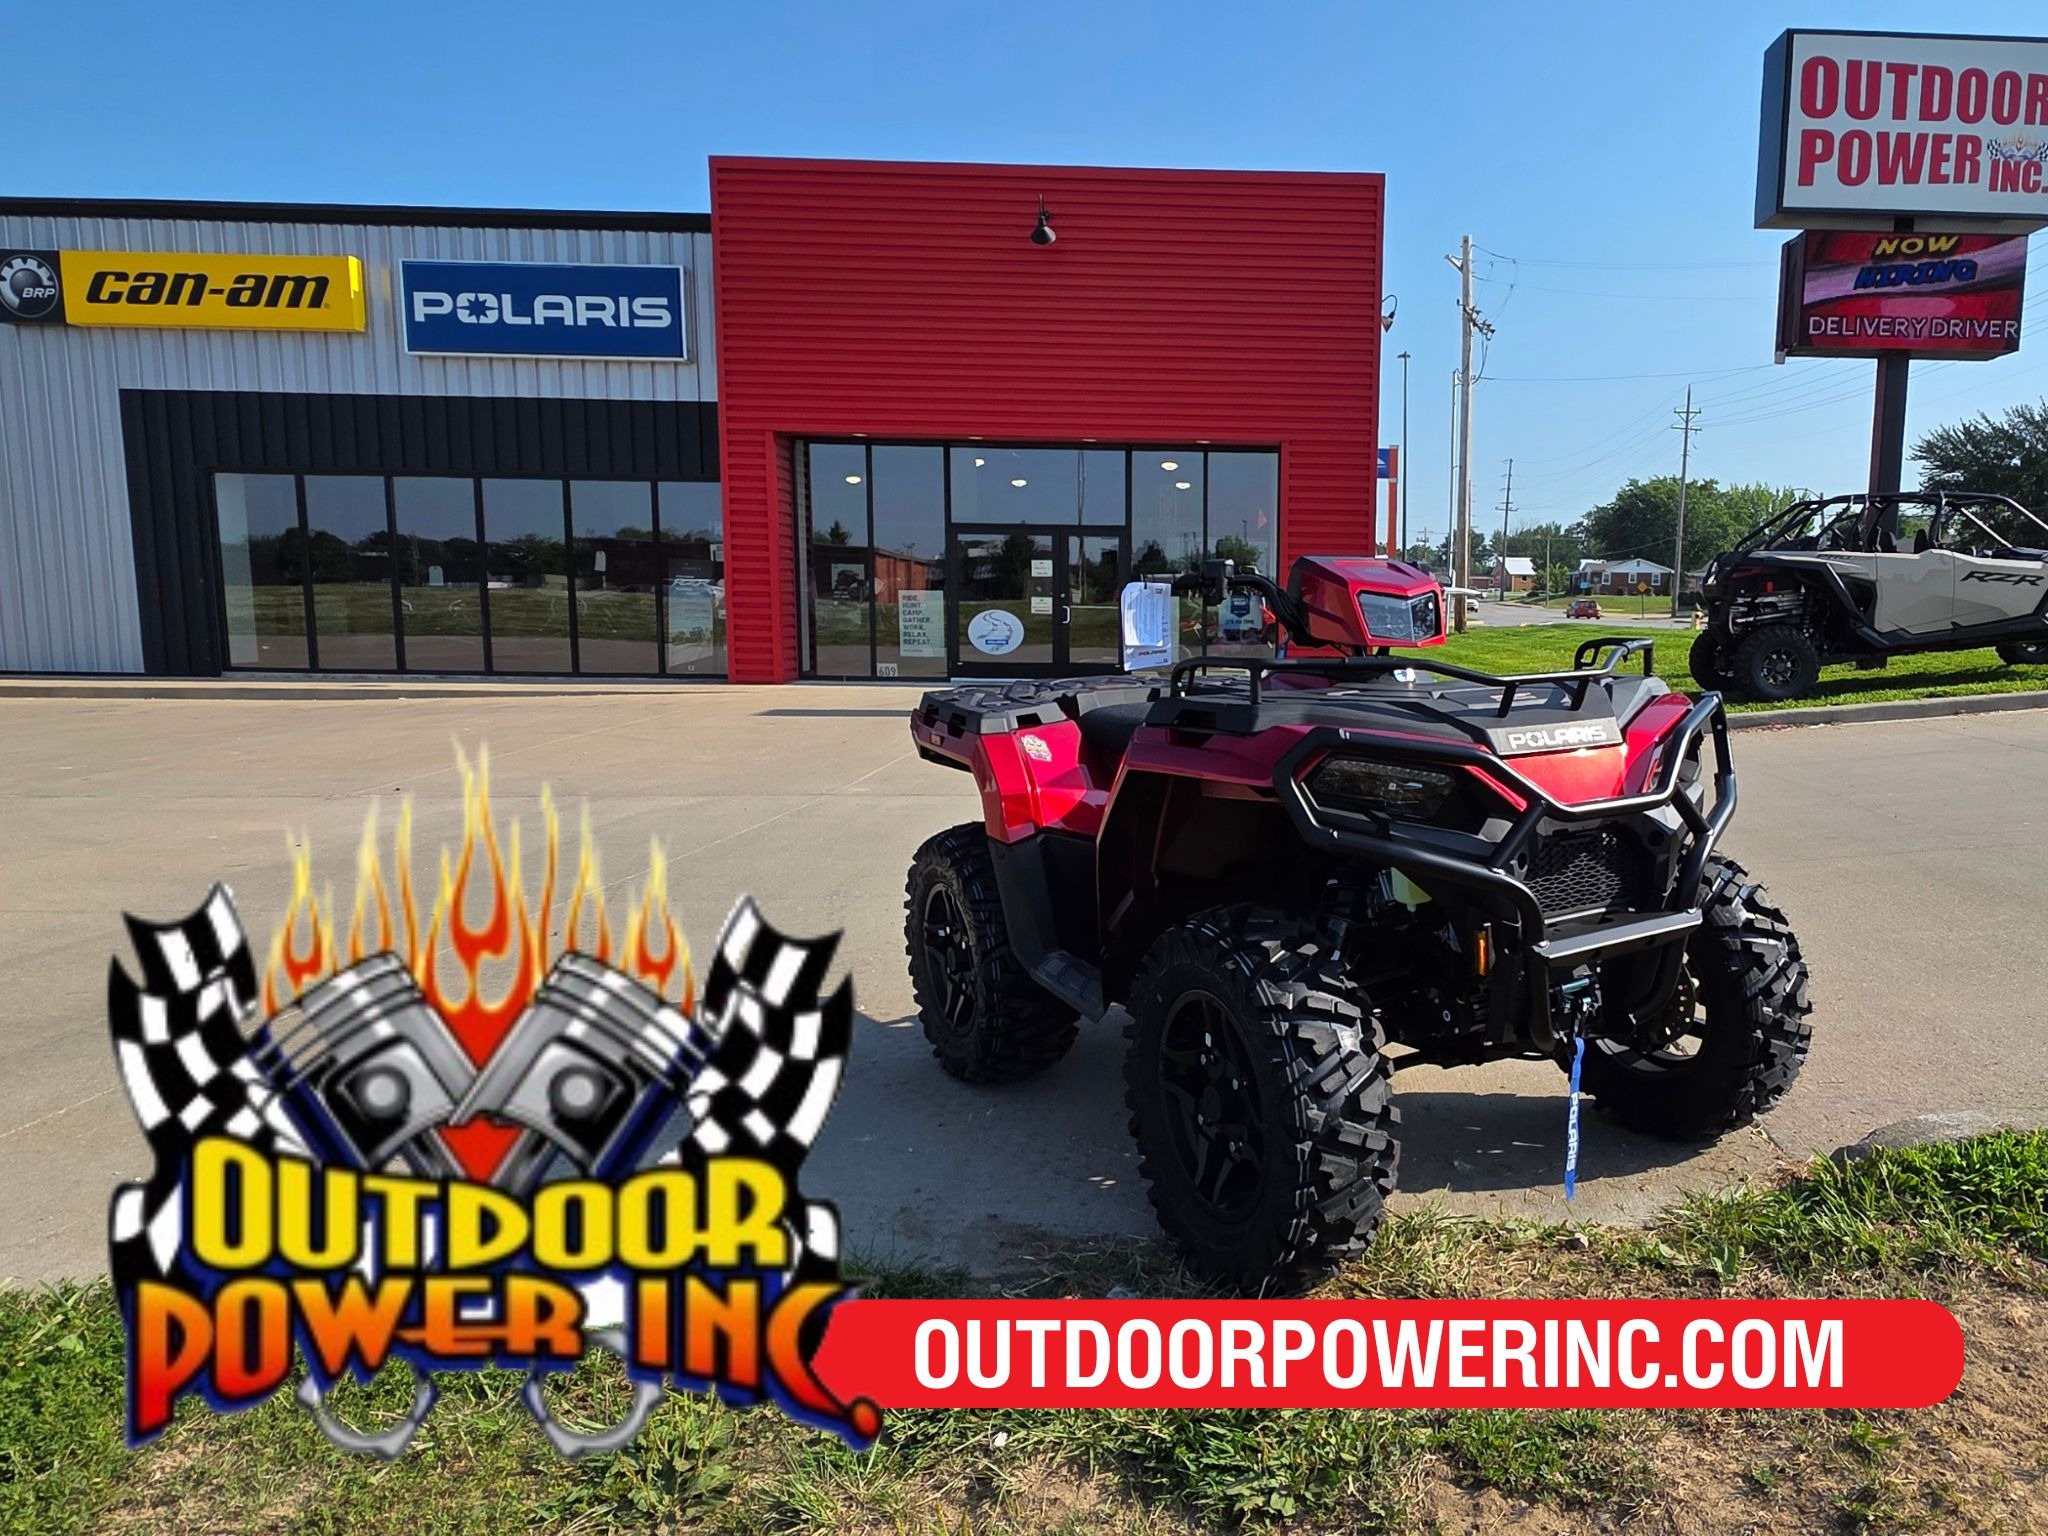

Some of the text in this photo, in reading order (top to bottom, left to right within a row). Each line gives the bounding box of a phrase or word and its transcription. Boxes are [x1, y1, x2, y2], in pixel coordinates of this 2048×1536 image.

[1800, 56, 2048, 125] OUTDOOR
[1797, 128, 1983, 188] POWER
[1875, 235, 1960, 256] NOW
[1853, 258, 1977, 291] HIRING
[22, 287, 56, 299] BRP
[85, 270, 330, 311] can-am
[412, 290, 673, 329] POLARIS
[1808, 316, 2020, 339] DELIVERY DRIVER
[1960, 570, 2046, 587] RZR
[878, 666, 896, 677] 609
[1508, 725, 1608, 750] POLARIS
[1565, 1091, 1580, 1172] POLARIS
